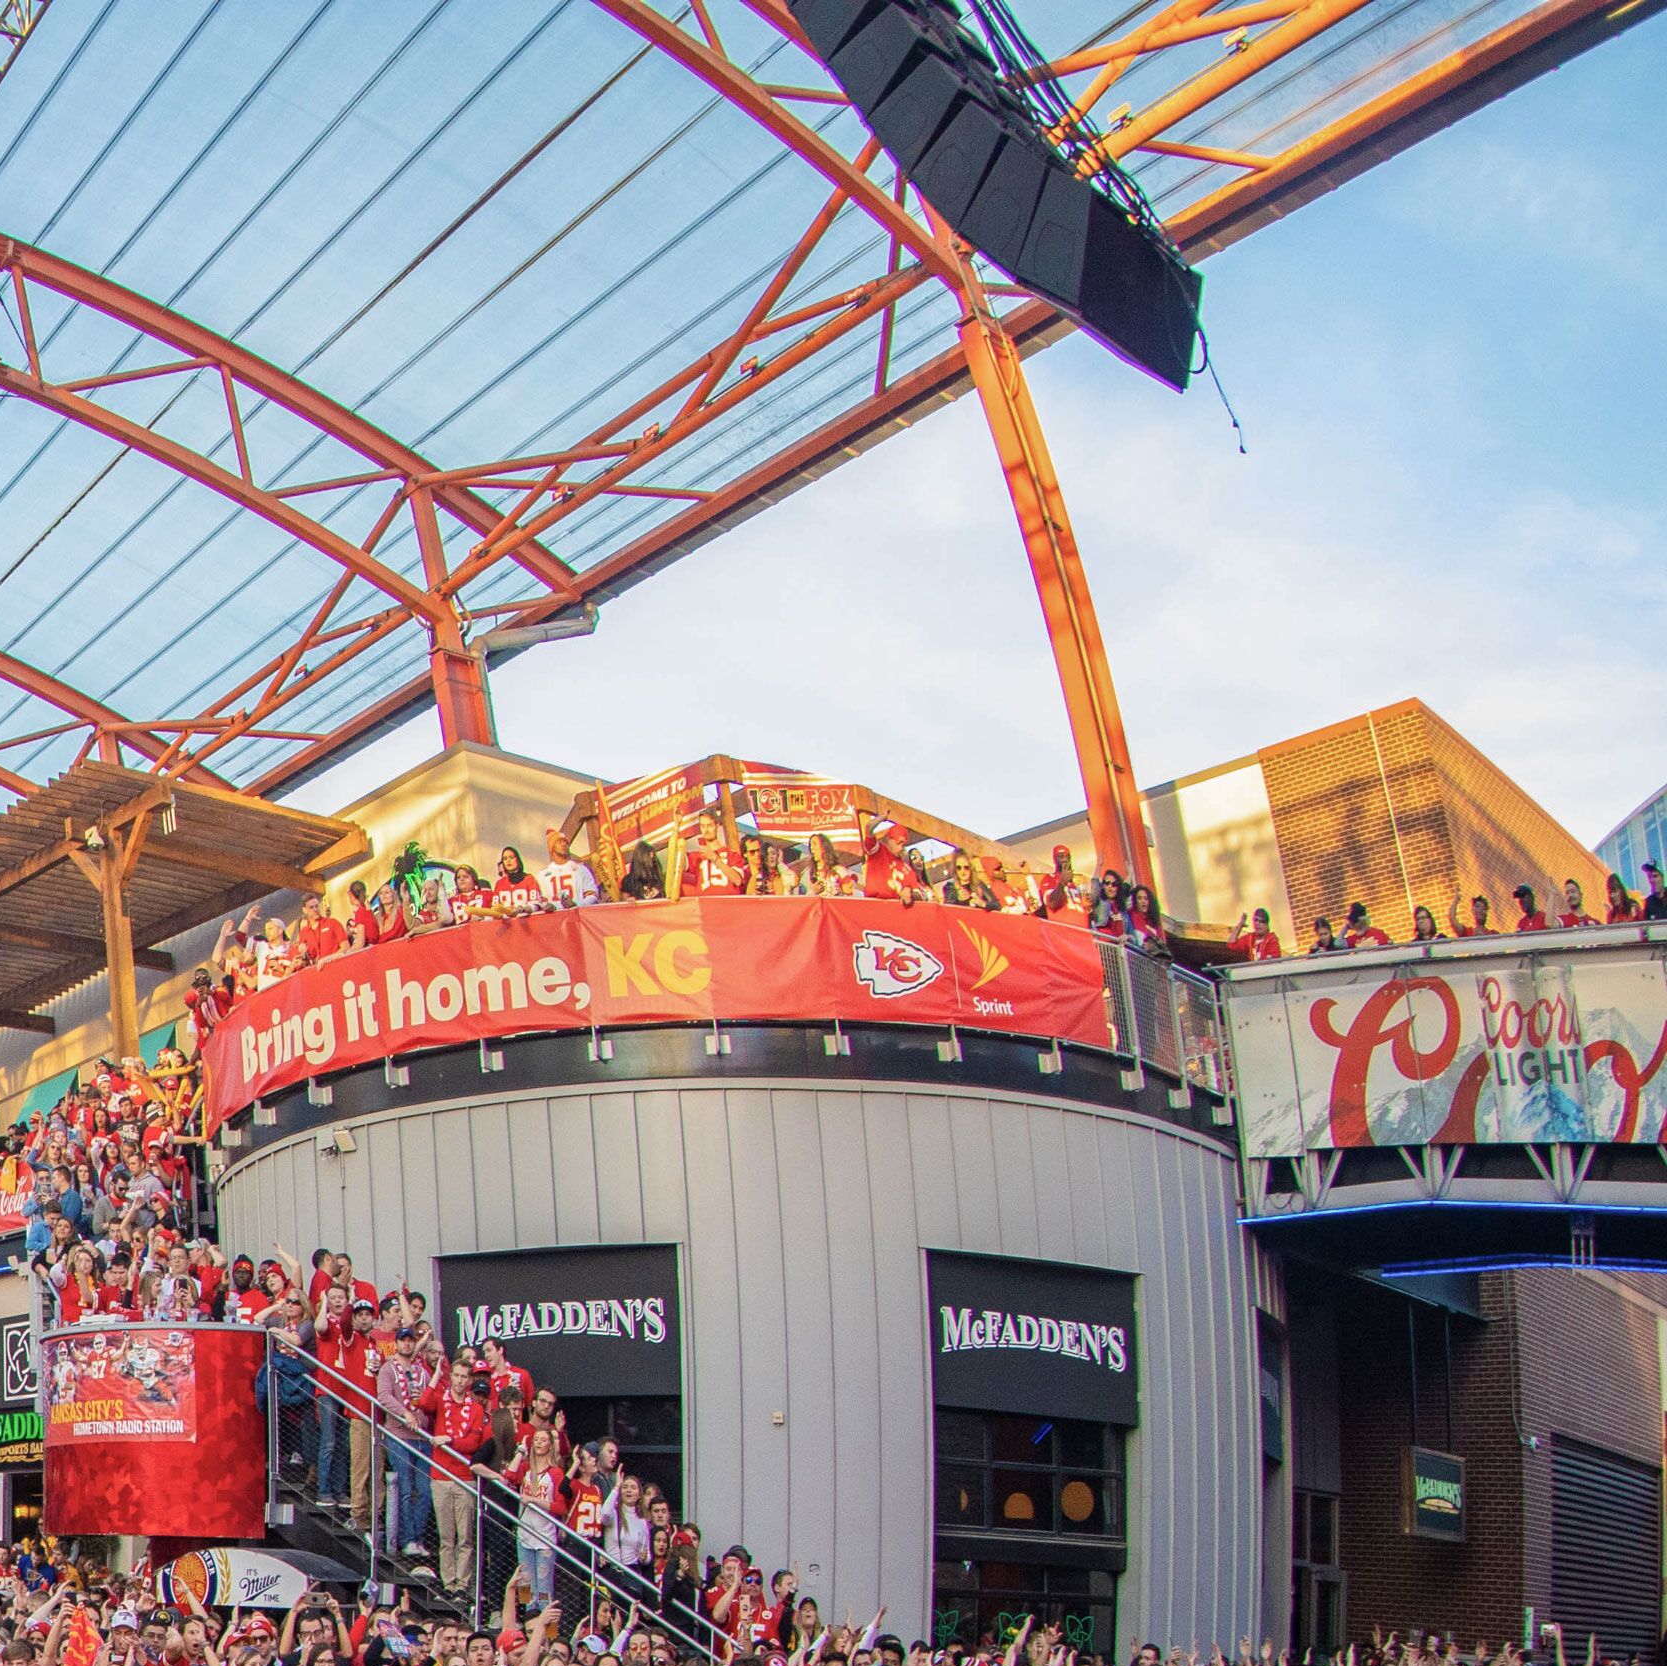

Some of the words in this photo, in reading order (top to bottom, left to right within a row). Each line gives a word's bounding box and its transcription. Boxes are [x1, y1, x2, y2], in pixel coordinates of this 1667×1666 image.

[611, 785, 669, 821] WELCOME
[670, 776, 686, 795] TO
[790, 793, 805, 807] THE
[805, 788, 850, 814] FOX
[549, 874, 574, 901] 15
[239, 1003, 337, 1085] Bring
[342, 979, 379, 1042] it
[384, 955, 591, 1030] home,
[603, 929, 713, 998] KC
[972, 996, 1014, 1017] Sprint
[1494, 1049, 1582, 1087] LIGHT
[455, 1297, 666, 1349] McFADDEN'S
[940, 1305, 1128, 1372] McFADDEN'S
[84, 1399, 124, 1423] CITY'S
[73, 1420, 114, 1437] HOMETOWN
[116, 1420, 142, 1435] RADIO
[144, 1419, 184, 1435] STATION
[246, 1568, 258, 1576] IT'S
[239, 1574, 281, 1602] Miller
[263, 1594, 281, 1602] TIME
